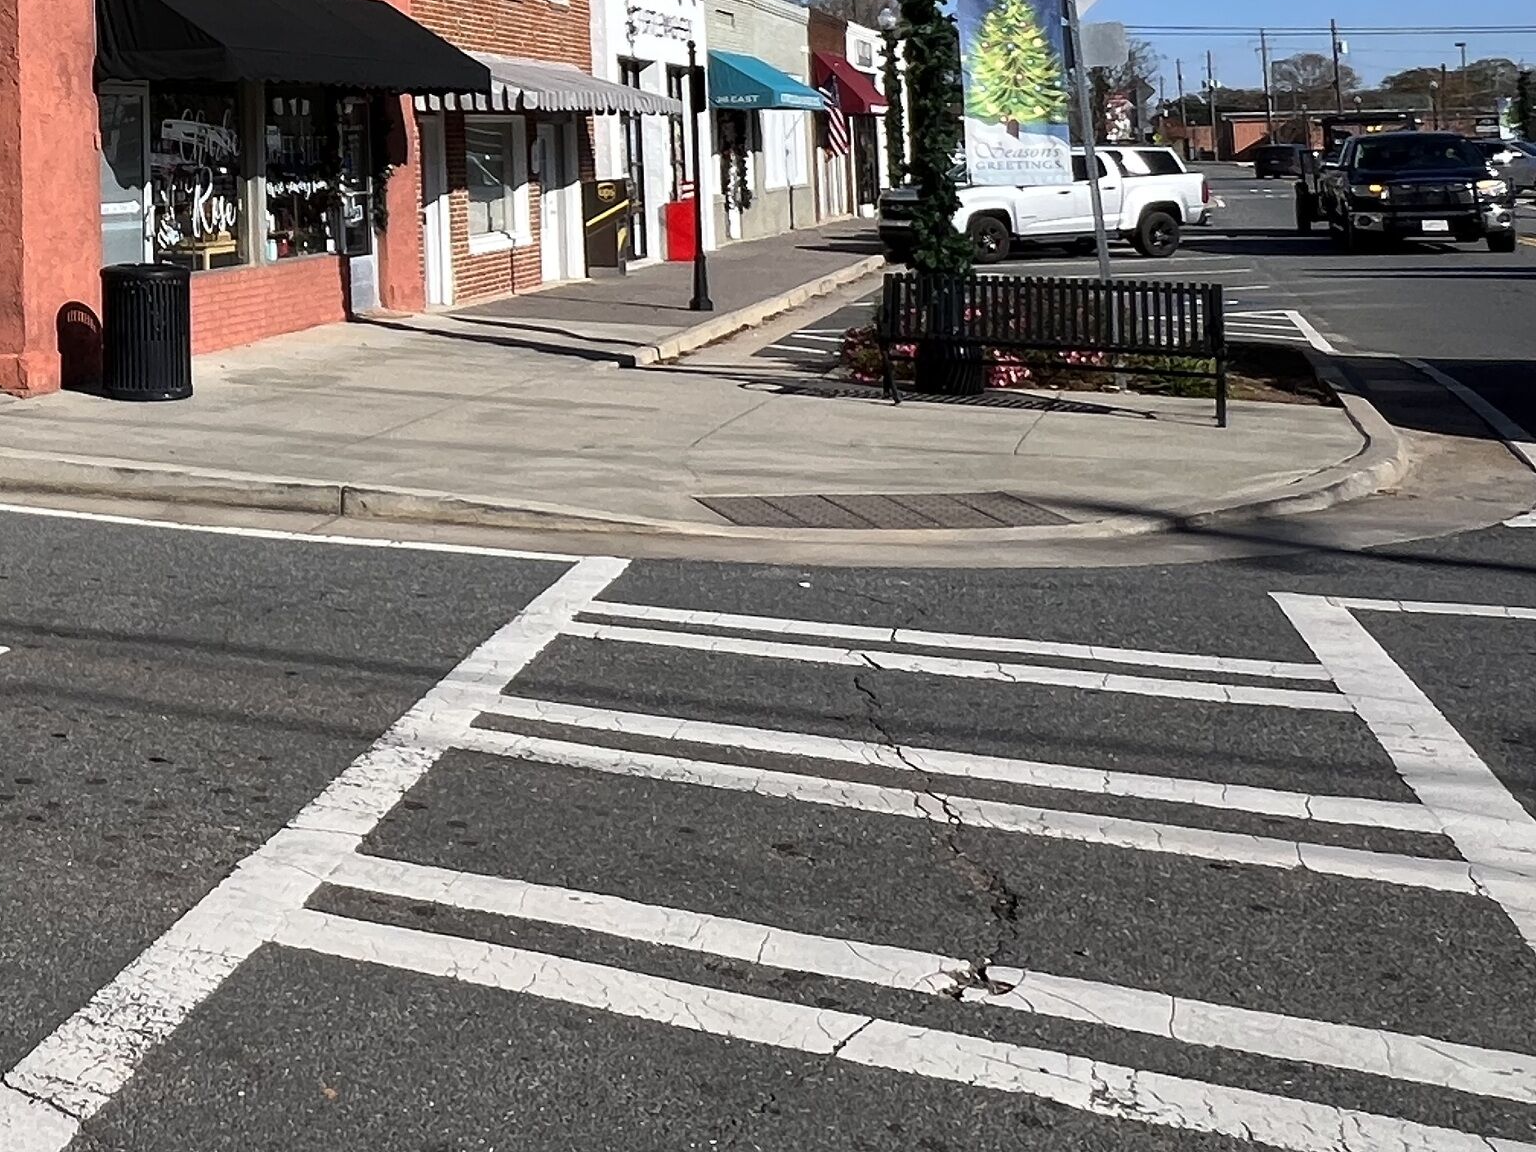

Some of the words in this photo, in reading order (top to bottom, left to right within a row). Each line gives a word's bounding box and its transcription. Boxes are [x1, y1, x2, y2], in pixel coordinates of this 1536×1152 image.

[730, 94, 761, 104] EAST
[972, 134, 1061, 160] Season's
[975, 159, 1065, 171] GREETINGS
